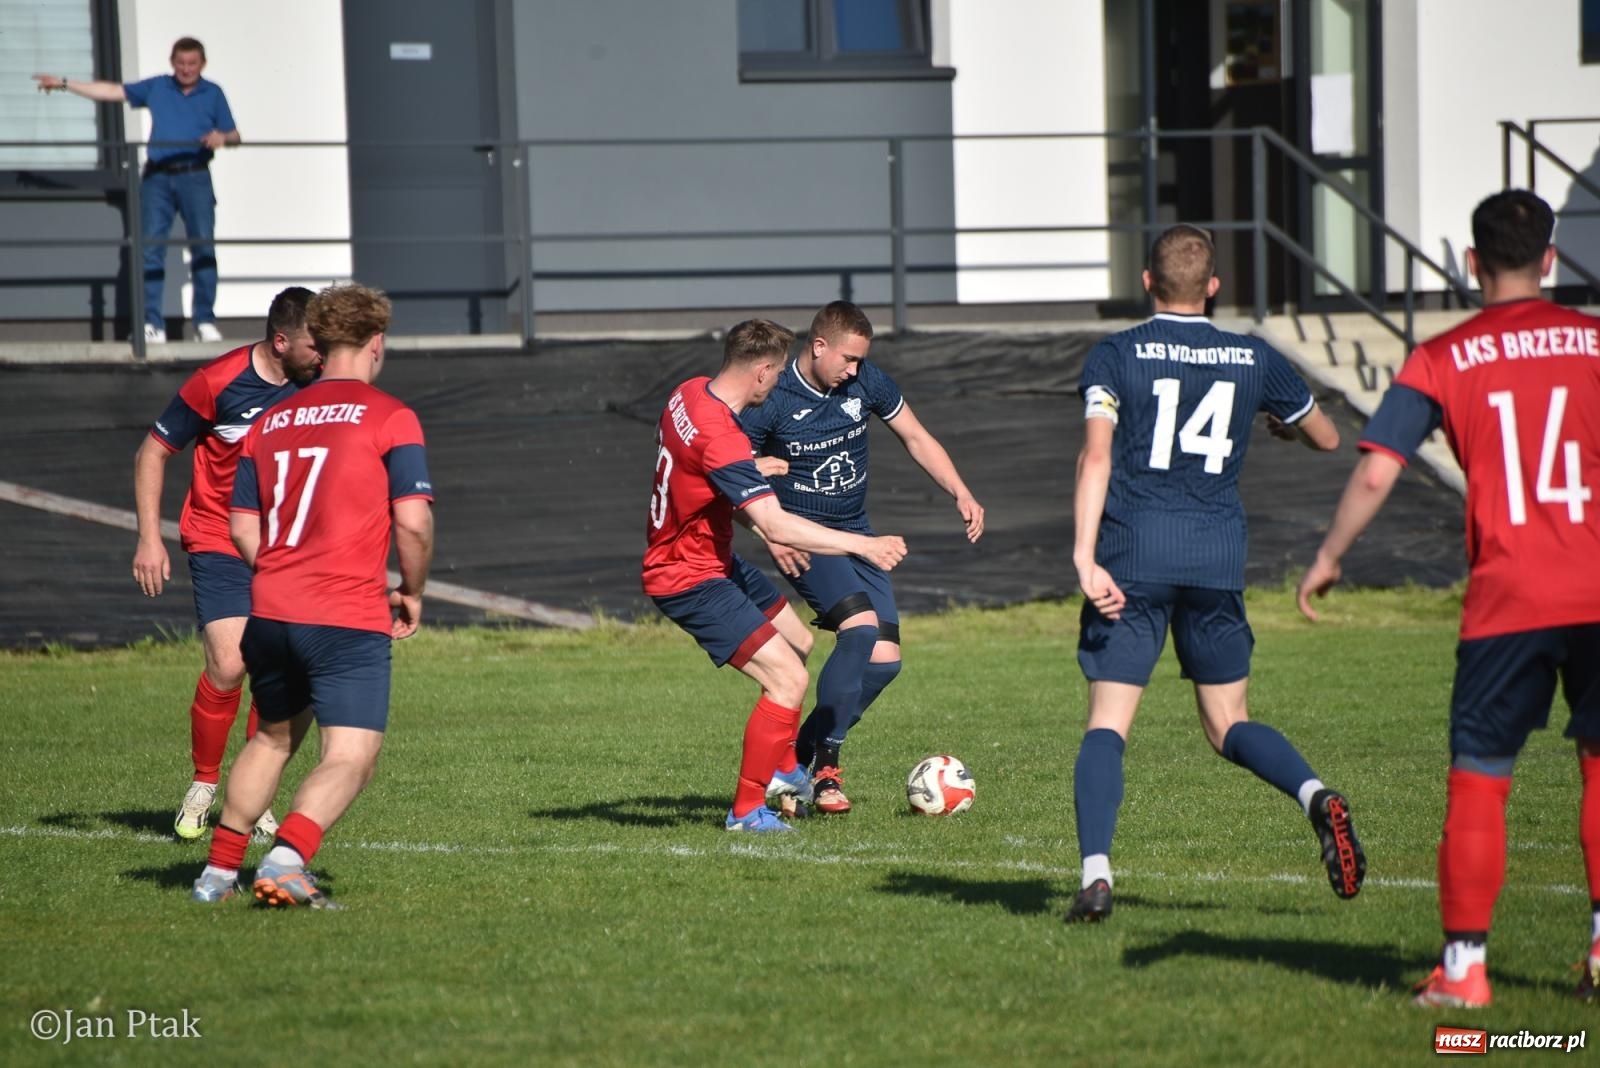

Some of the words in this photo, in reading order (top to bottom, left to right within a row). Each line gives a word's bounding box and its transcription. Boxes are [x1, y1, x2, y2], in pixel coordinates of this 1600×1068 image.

[1135, 342, 1167, 360] LKS
[1168, 343, 1255, 366] WOJNOWICE
[1451, 334, 1499, 372] LKS
[1501, 326, 1600, 360] BRZEZIE
[262, 409, 293, 434] LKS
[293, 403, 368, 425] BRZEZIE
[803, 436, 844, 452] MASTER
[1149, 377, 1236, 475] 14
[1487, 386, 1592, 526] 14
[268, 446, 329, 547] 17
[650, 429, 673, 530] 3
[1327, 797, 1358, 894] PREDATOR
